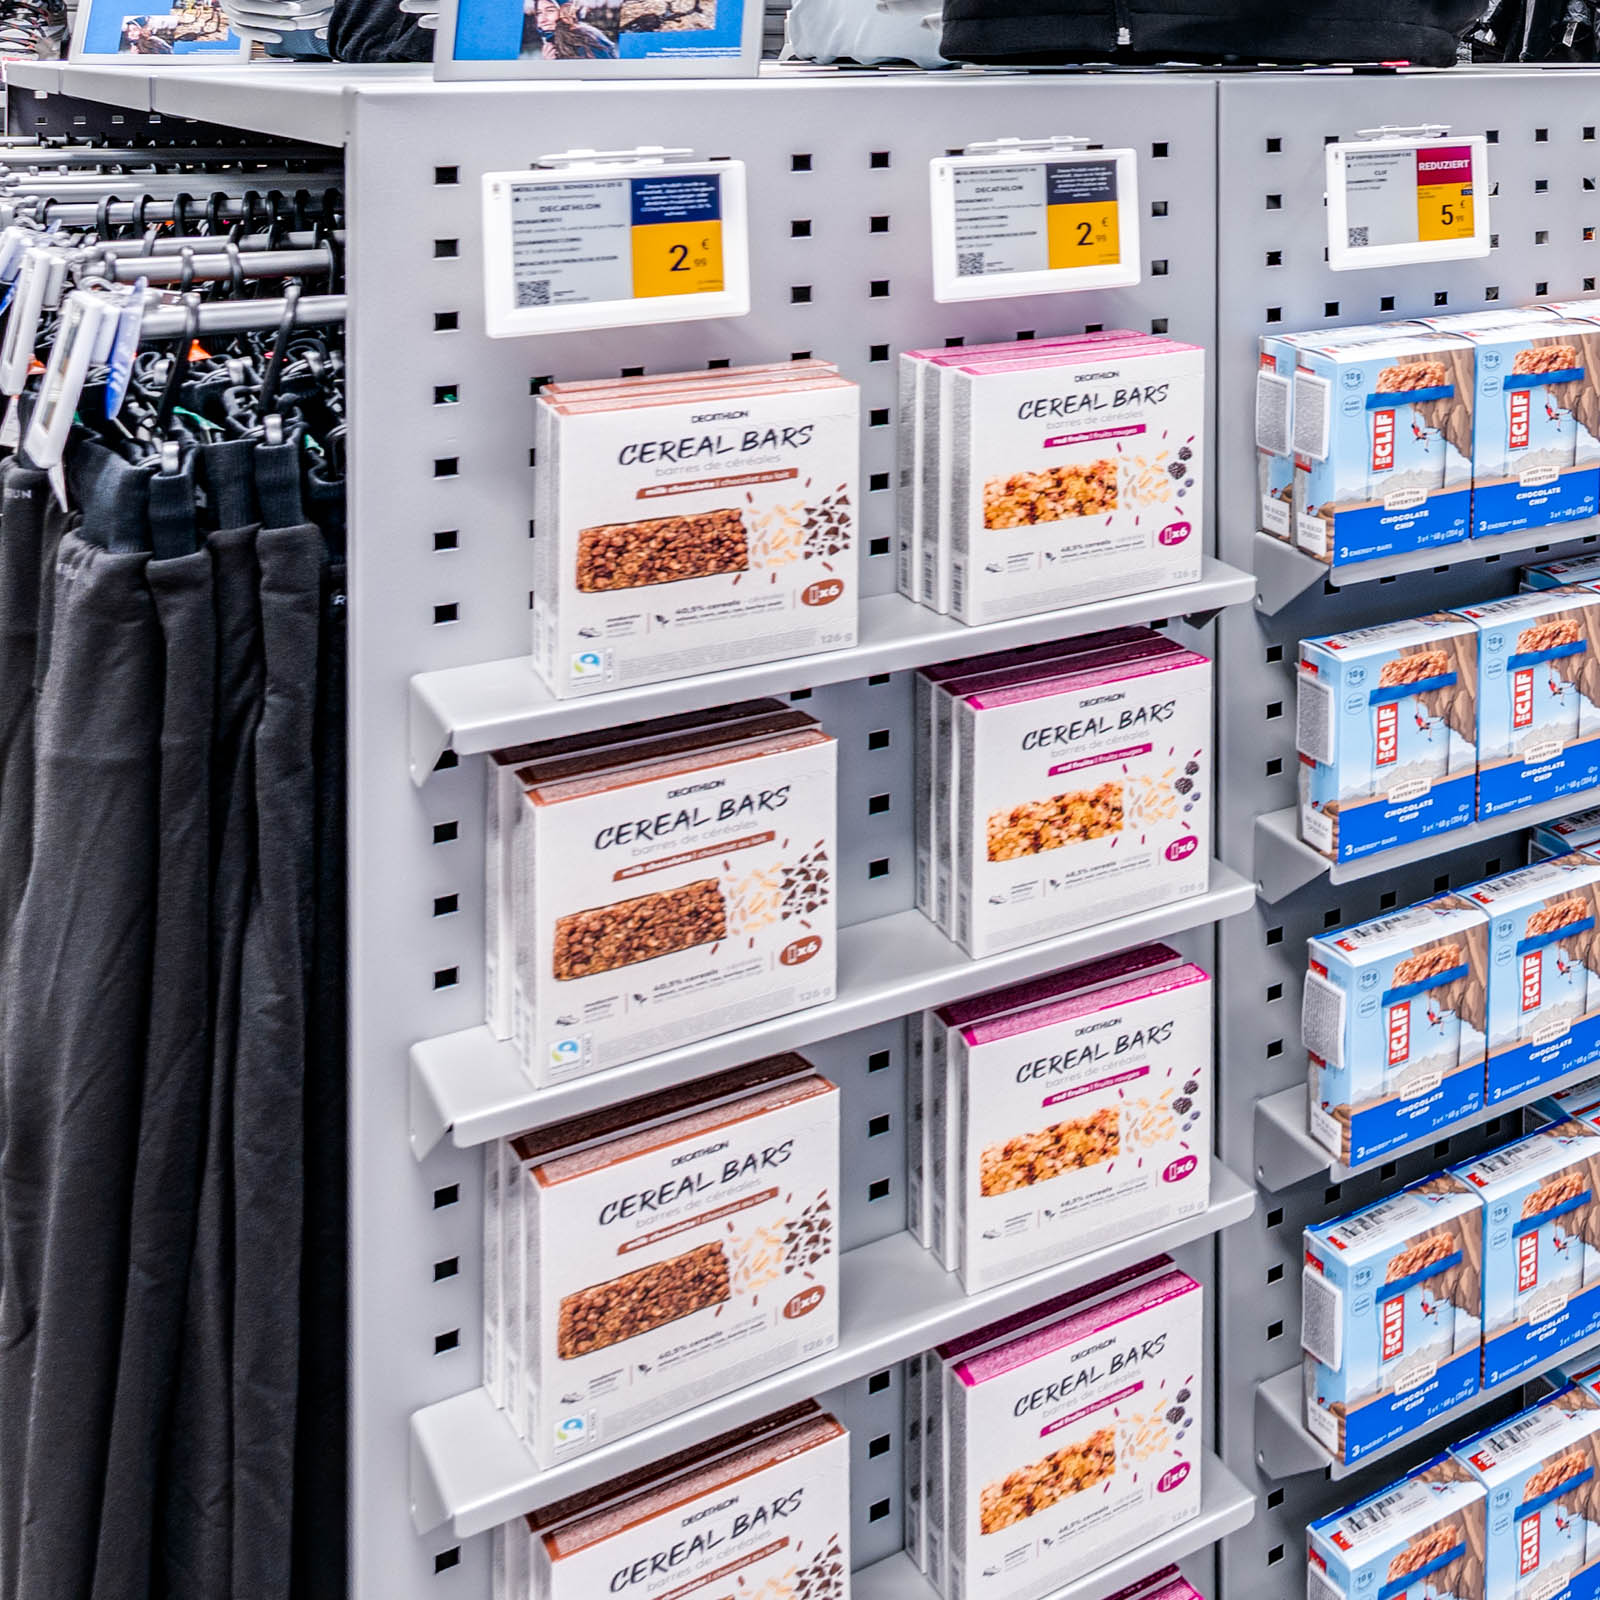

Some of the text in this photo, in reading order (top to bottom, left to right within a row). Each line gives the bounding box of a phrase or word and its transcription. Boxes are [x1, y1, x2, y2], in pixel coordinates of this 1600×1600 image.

[1418, 159, 1470, 171] REDUZIERT
[975, 185, 1024, 194] DECATHLON
[539, 202, 602, 213] DECATHLON
[1441, 204, 1454, 225] 5
[701, 238, 710, 250] €
[1076, 222, 1095, 246] 2
[669, 244, 690, 272] 2
[1074, 371, 1120, 383] DECATHLON
[1018, 383, 1169, 420] CEREAL BARS
[691, 410, 749, 424] DECATHLON
[1046, 417, 1083, 430] barres
[1085, 415, 1099, 425] de
[1511, 395, 1529, 435] CLIF
[617, 424, 815, 466] CEREAL BARS
[1374, 414, 1393, 455] CLIF
[655, 454, 781, 478] barres de céréales
[1516, 488, 1561, 500] CHOCOLATE
[1529, 497, 1548, 506] CHIP
[1380, 510, 1429, 525] CHOCOLATE
[1394, 521, 1415, 531] CHIP
[1172, 527, 1188, 538] x6
[819, 585, 840, 599] x6
[1079, 693, 1126, 708] DECATHLON
[1515, 674, 1533, 713] CLIF
[1022, 700, 1177, 751] CEREAL BARS
[1378, 707, 1397, 749] CLIF
[667, 779, 725, 799] DECATHLON
[594, 785, 791, 850] CEREAL BARS
[1524, 956, 1541, 996] CLIF
[1074, 1017, 1123, 1037] DECATHLON
[1391, 1007, 1410, 1049] CLIF
[1016, 1020, 1175, 1084] CEREAL BARS
[671, 1140, 730, 1167] DECATHLON
[599, 1171, 715, 1226] CEREAL
[721, 1140, 795, 1182] BARS
[1521, 1237, 1537, 1276] CLIF
[1385, 1301, 1403, 1343] CLIF
[1070, 1337, 1117, 1363] DECATHLON
[1014, 1333, 1168, 1417] CEREAL BARS
[681, 1495, 740, 1528] DECATHLON
[609, 1488, 804, 1593] CEREAL BARS
[1522, 1516, 1540, 1559] CLIF
